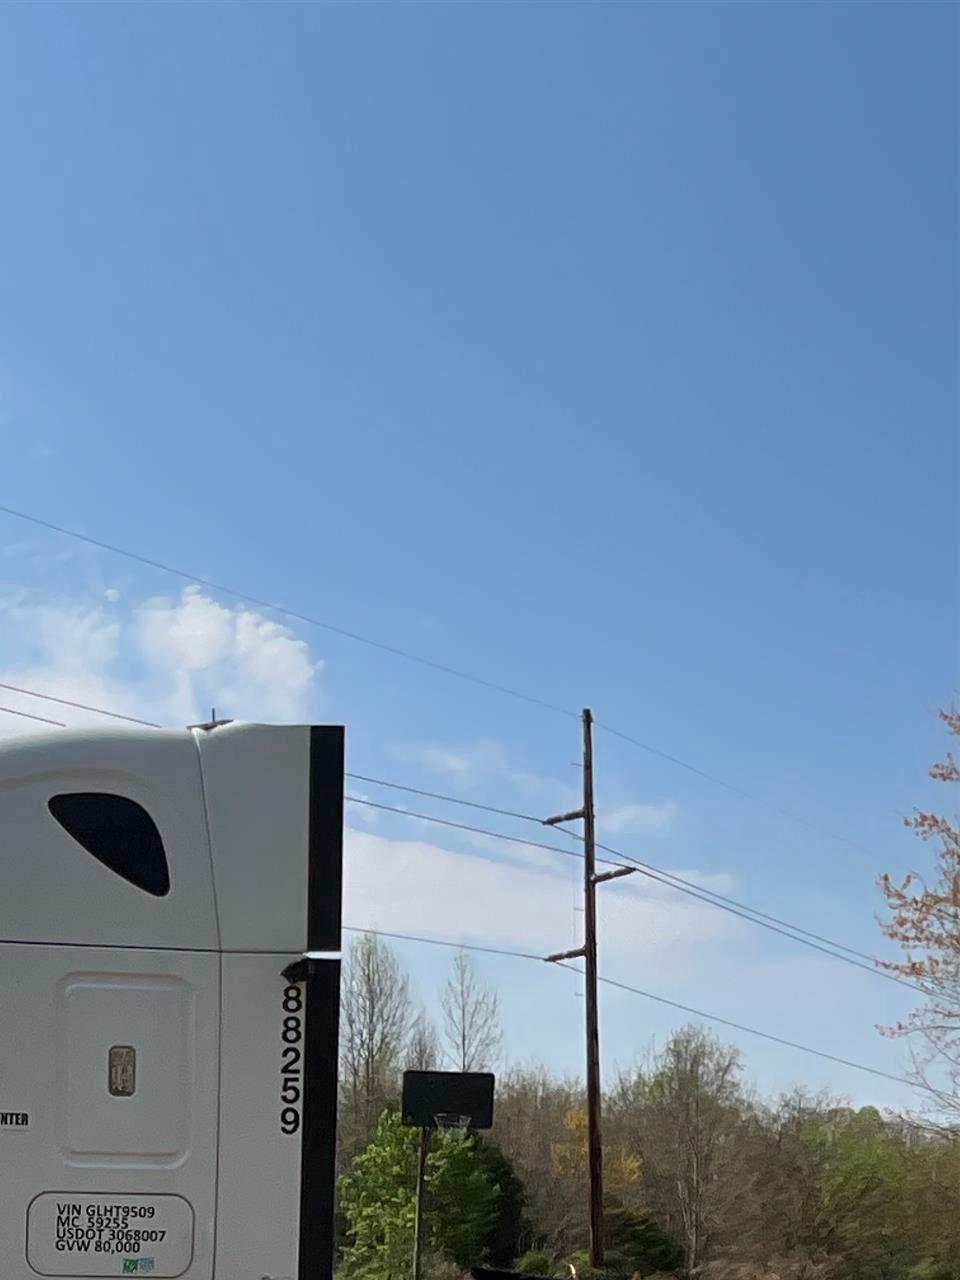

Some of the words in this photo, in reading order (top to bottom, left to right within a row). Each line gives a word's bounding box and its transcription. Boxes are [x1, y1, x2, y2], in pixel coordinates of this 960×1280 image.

[280, 984, 303, 1136] 88259
[57, 1203, 81, 1216] VIN
[86, 1205, 155, 1218] GLHT9509
[56, 1216, 80, 1228] MC
[88, 1217, 129, 1229] 59255
[56, 1228, 104, 1240] USDOT
[109, 1230, 167, 1242] 3068007
[56, 1240, 90, 1252] GVW
[94, 1241, 141, 1254] 80,000
